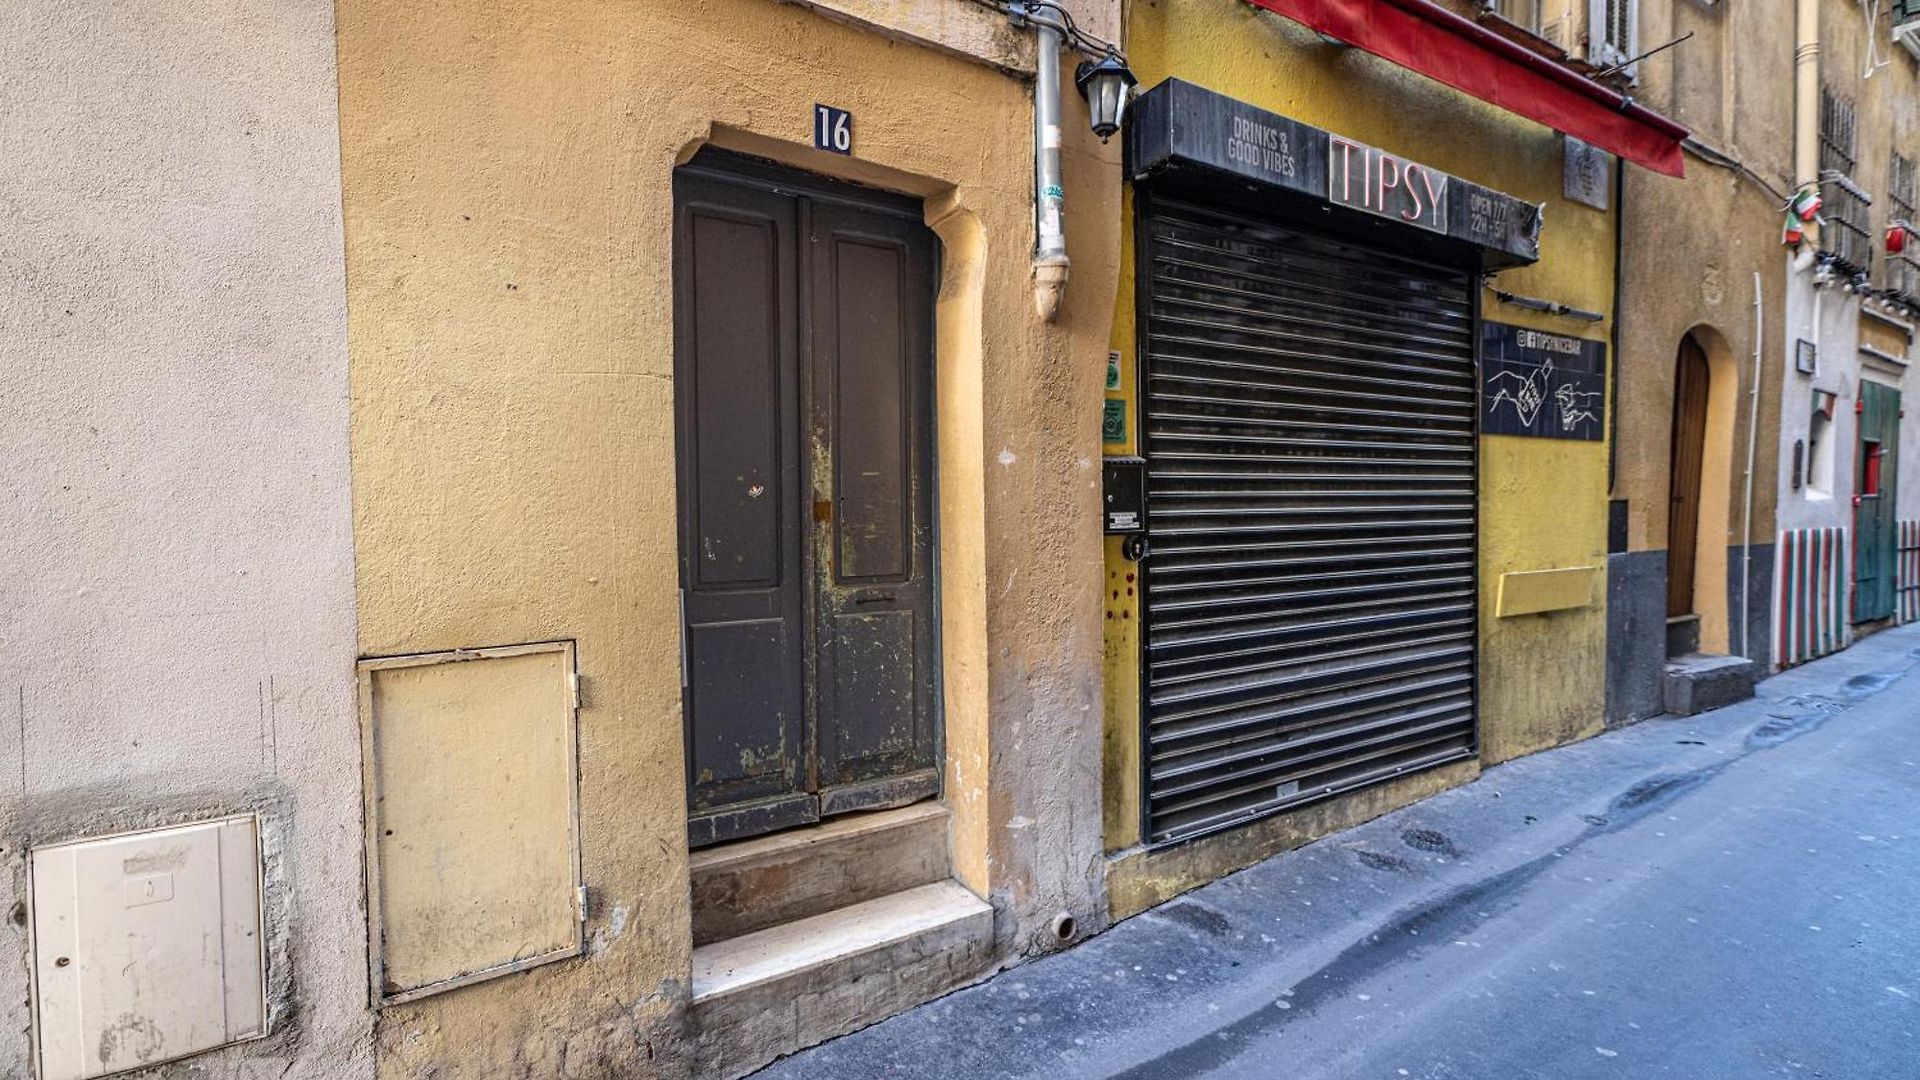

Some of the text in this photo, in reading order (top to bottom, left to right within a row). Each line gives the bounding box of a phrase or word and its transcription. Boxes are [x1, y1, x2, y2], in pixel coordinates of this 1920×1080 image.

[819, 108, 850, 151] 16
[1234, 117, 1289, 154] DRINKS &
[1228, 138, 1295, 178] GOOD VIBES
[1333, 138, 1446, 226] TIPSY
[1471, 194, 1491, 216] OPEN
[1471, 213, 1487, 233] 22H
